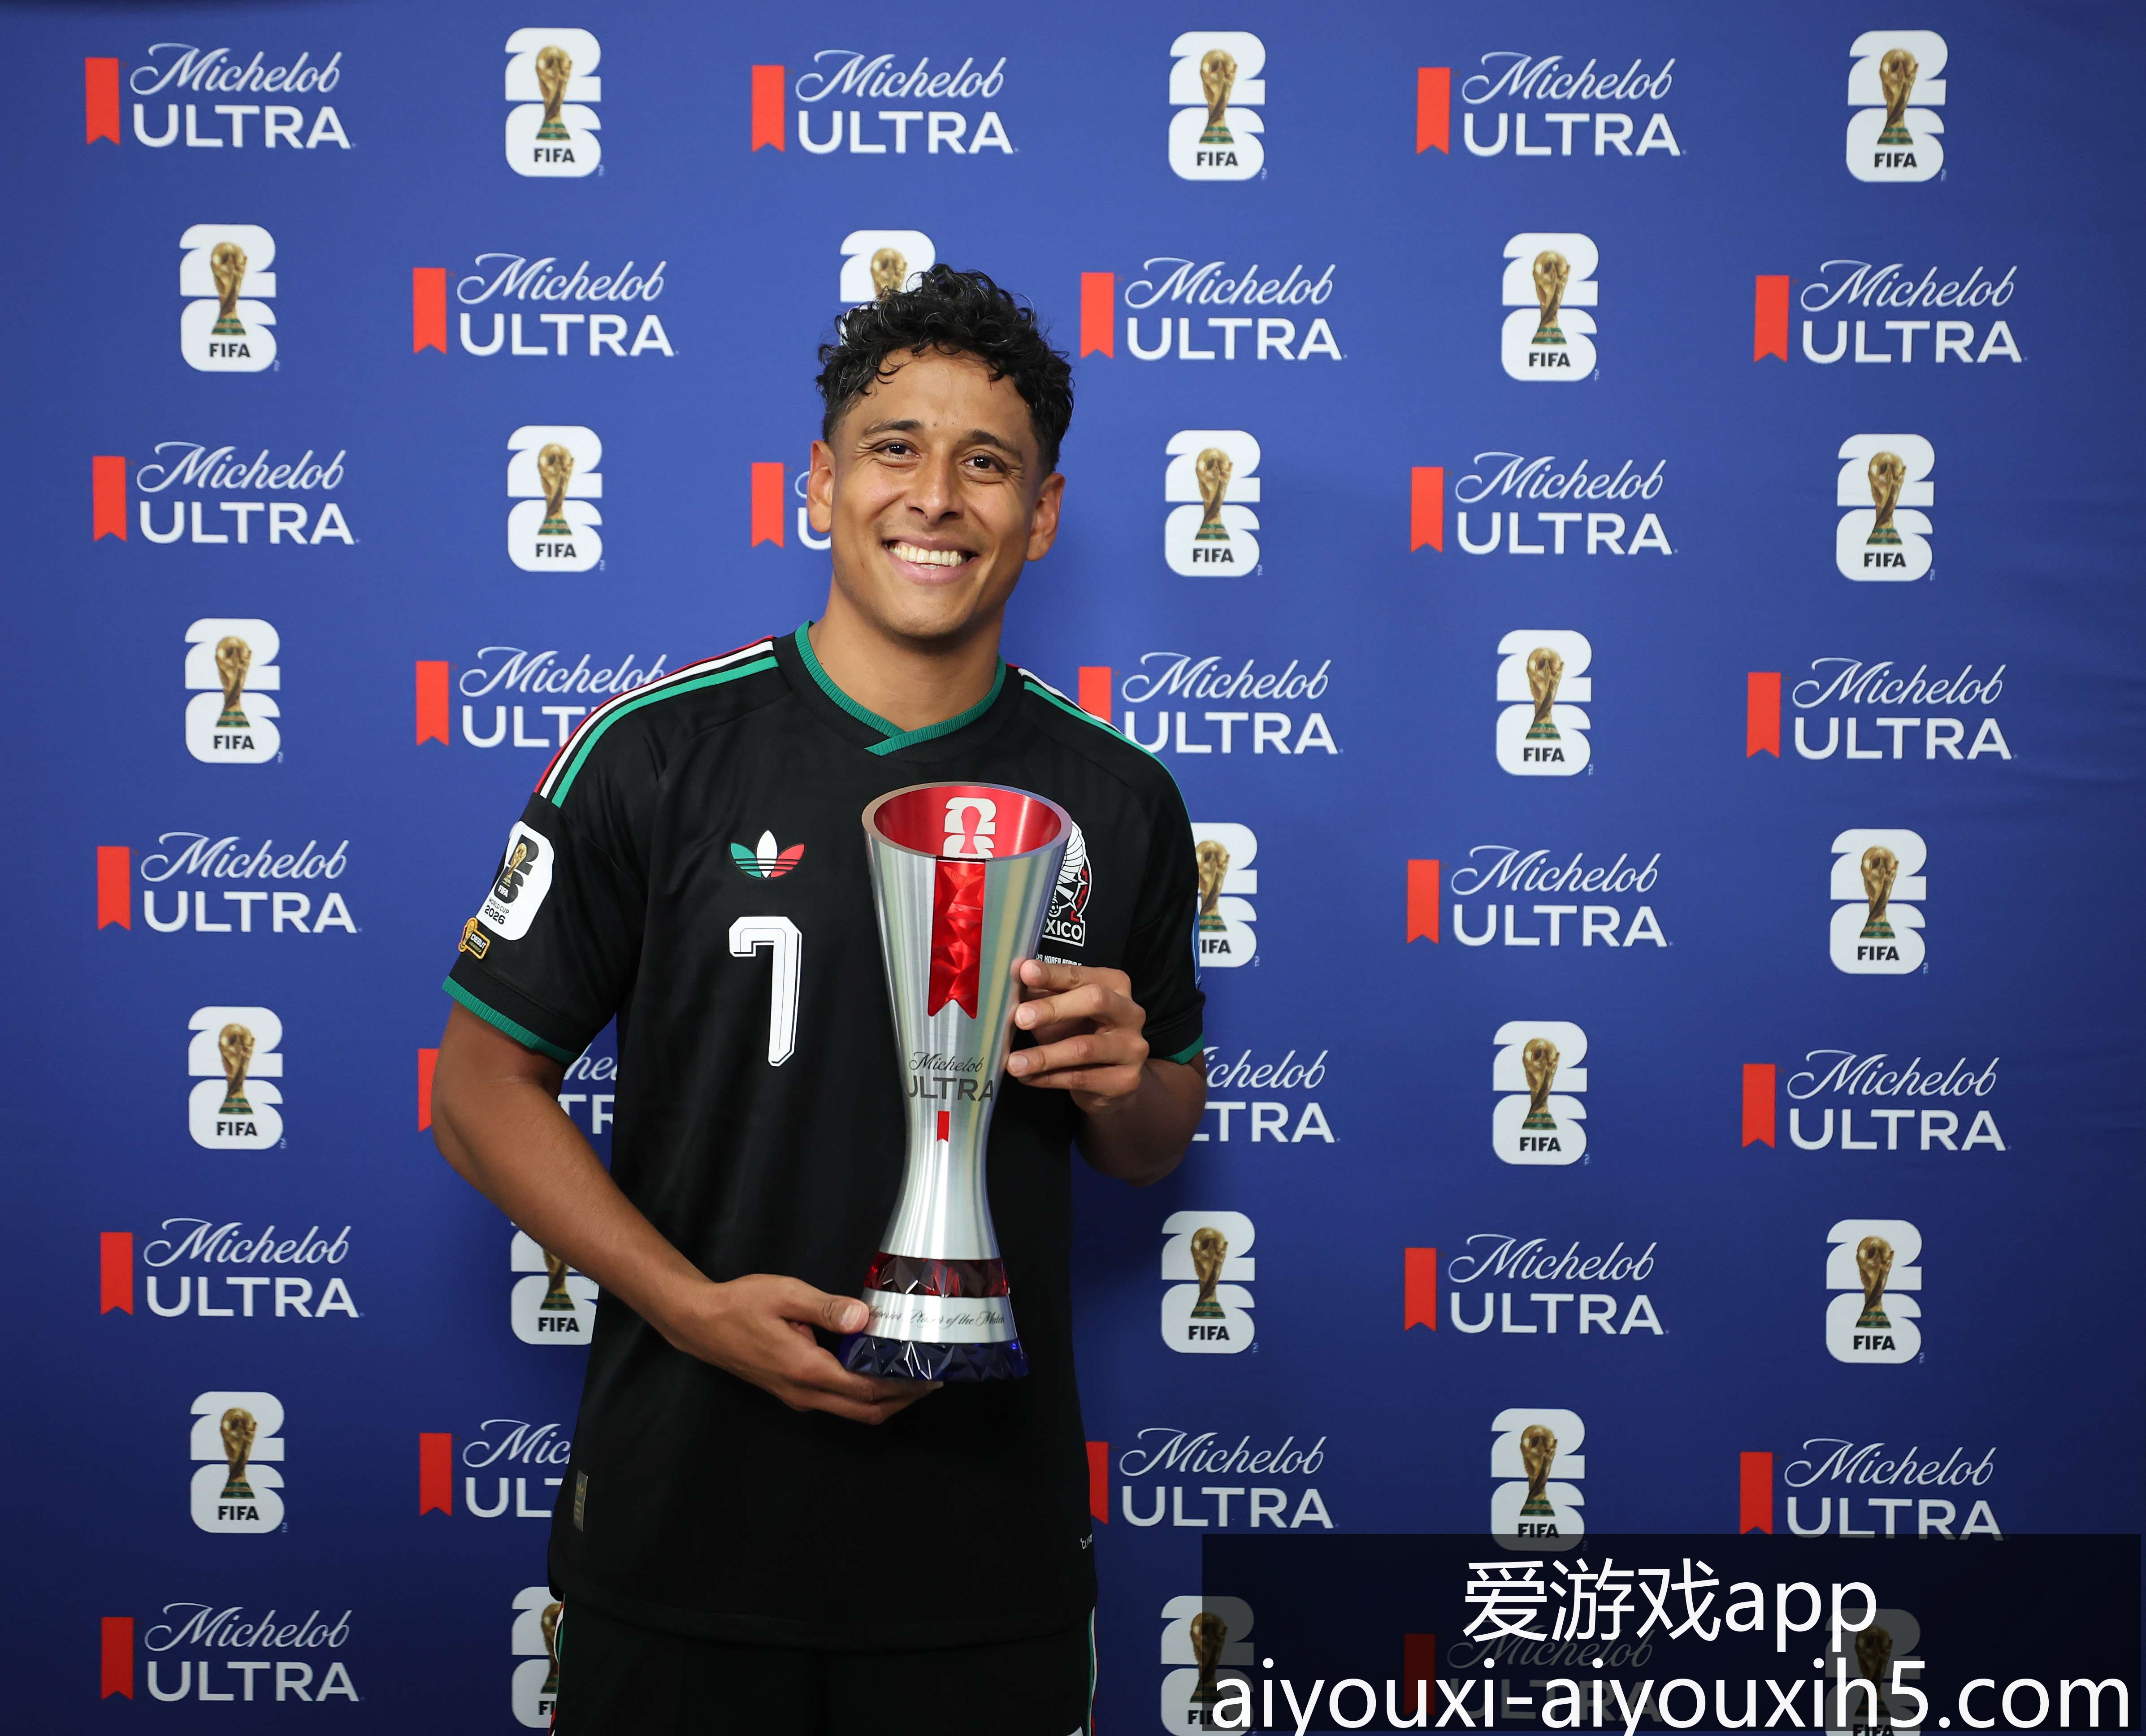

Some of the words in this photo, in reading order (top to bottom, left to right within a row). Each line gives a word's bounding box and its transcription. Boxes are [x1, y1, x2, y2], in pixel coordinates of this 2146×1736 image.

[130, 43, 342, 95] Michelob
[796, 50, 1006, 102] Michelob
[1462, 52, 1675, 104] Michelob
[134, 104, 351, 149] ULTRA
[798, 110, 1014, 154] ULTRA
[1464, 113, 1681, 156] ULTRA
[534, 148, 575, 162] FIFA
[1197, 152, 1238, 166] FIFA
[1874, 153, 1917, 167] FIFA
[457, 253, 666, 304] Michelob
[1125, 257, 1335, 308] Michelob
[1801, 260, 2017, 312] Michelob
[210, 343, 250, 357] FIFA
[460, 313, 674, 356] ULTRA
[1127, 317, 1342, 360] ULTRA
[1803, 321, 2022, 364] ULTRA
[1529, 353, 1570, 367] FIFA
[137, 442, 346, 492] Michelob
[1456, 452, 1666, 503] Michelob
[140, 501, 354, 545] ULTRA
[1457, 512, 1672, 555] ULTRA
[536, 543, 576, 557] FIFA
[1193, 548, 1234, 562] FIFA
[1864, 553, 1906, 567] FIFA
[1122, 652, 1331, 703] Michelob
[1793, 658, 2006, 708] Michelob
[214, 735, 254, 749] FIFA
[463, 706, 586, 748] ULT
[1124, 711, 1338, 754] ULTRA
[1795, 717, 2012, 760] ULTRA
[1523, 747, 1565, 762] FIFA
[141, 832, 348, 881] Michelob
[1452, 845, 1660, 895] Michelob
[144, 890, 356, 933] ULTRA
[498, 885, 509, 897] FIFA
[500, 906, 510, 915] CUP
[485, 905, 506, 925] 2026
[1045, 918, 1082, 940] XICO
[1453, 904, 1667, 947] ULTRA
[1200, 940, 1231, 954] IFA
[1857, 946, 1899, 960] FIFA
[729, 916, 802, 1067] 7
[909, 1052, 985, 1073] Michelob
[1203, 1046, 1328, 1089] chelob
[1787, 1050, 1999, 1099] Michelob
[217, 1122, 257, 1136] FIFA
[1520, 1137, 1561, 1151] FIFA
[1790, 1108, 2006, 1151] ULTRA
[144, 1218, 351, 1267] Michelob
[1451, 1234, 1656, 1283] Michelob
[147, 1276, 359, 1318] ULTRA
[1451, 1292, 1664, 1335] ULTRA
[538, 1317, 579, 1332] FIFA
[1188, 1325, 1230, 1341] FIFA
[1854, 1335, 1896, 1350] FIFA
[1119, 1428, 1327, 1476] Michelob
[1785, 1438, 1996, 1487] Michelob
[218, 1506, 259, 1520] FIFA
[1123, 1486, 1334, 1528] ULTRA
[1787, 1497, 2003, 1541] ULTRA
[1518, 1523, 1560, 1538] FIFA
[145, 1603, 352, 1651] Michelob
[148, 1661, 359, 1701] ULTRA
